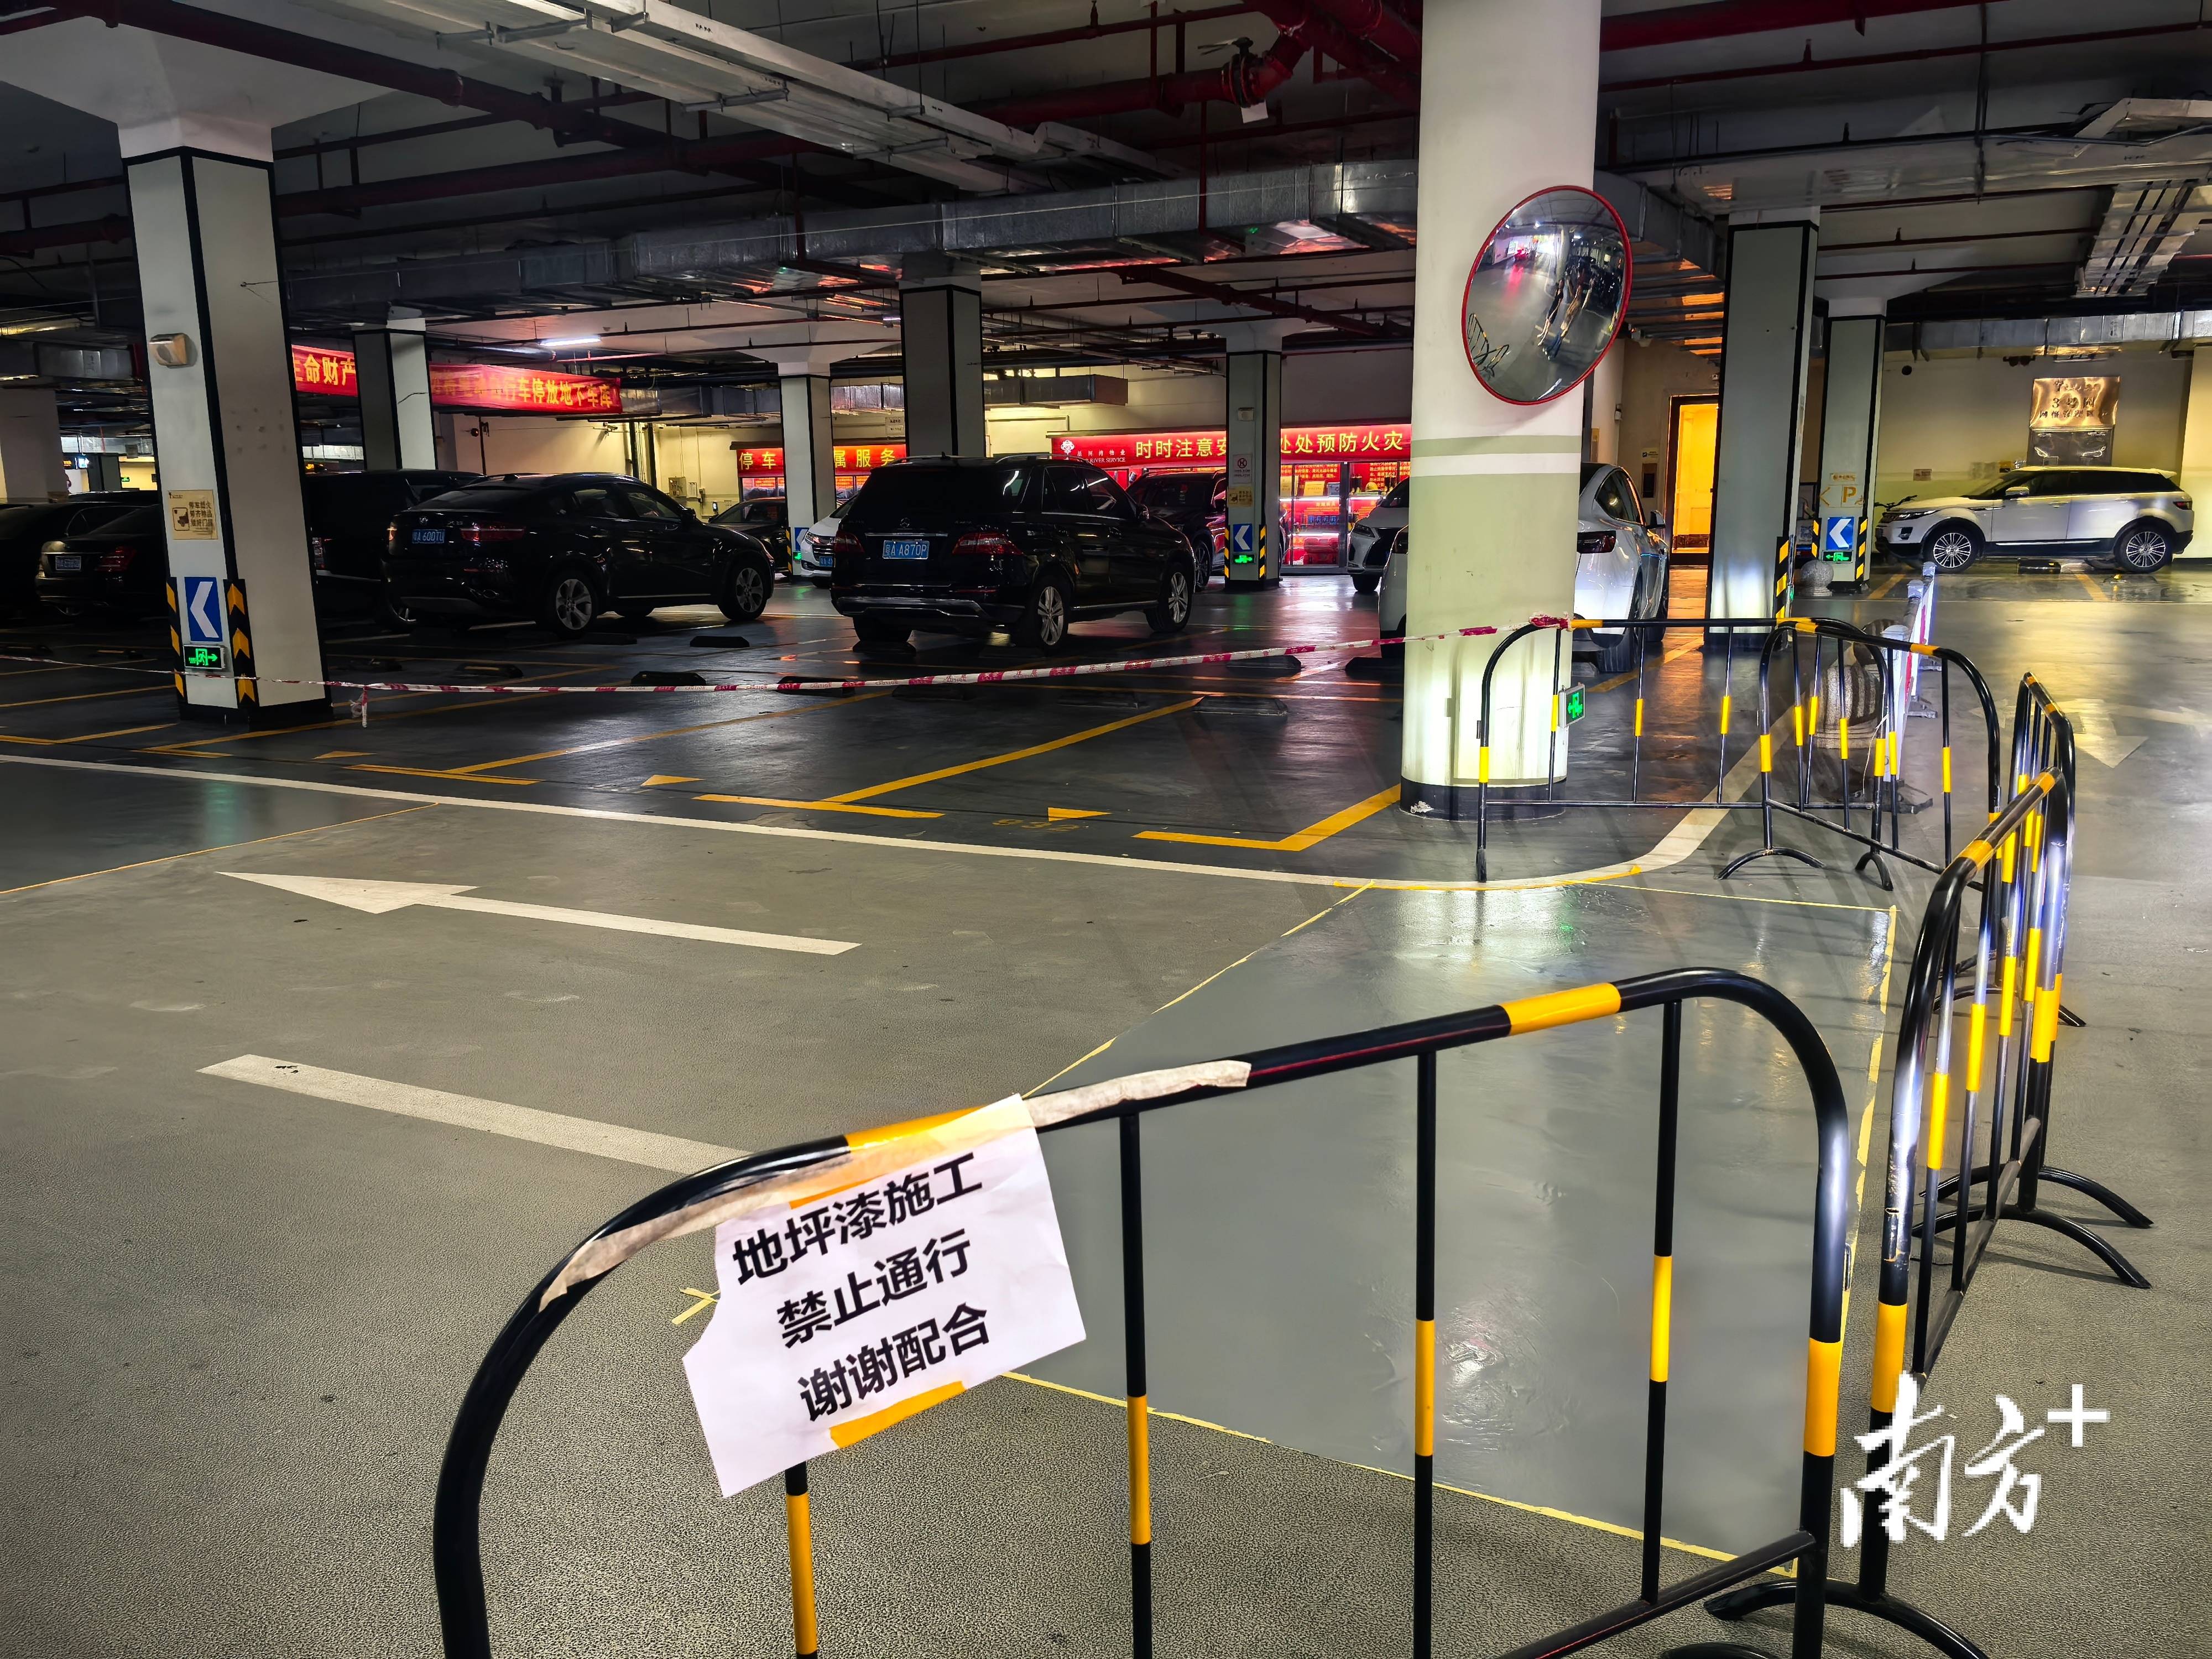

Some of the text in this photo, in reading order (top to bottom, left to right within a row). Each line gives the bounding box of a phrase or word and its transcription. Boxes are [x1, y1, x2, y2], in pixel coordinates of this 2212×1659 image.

[739, 448, 895, 469] 停车 属服务
[1843, 486, 1856, 503] P
[733, 1152, 982, 1285] 地坪漆施工
[777, 1228, 971, 1348] 禁止通行
[797, 1302, 990, 1422] 谢谢配合
